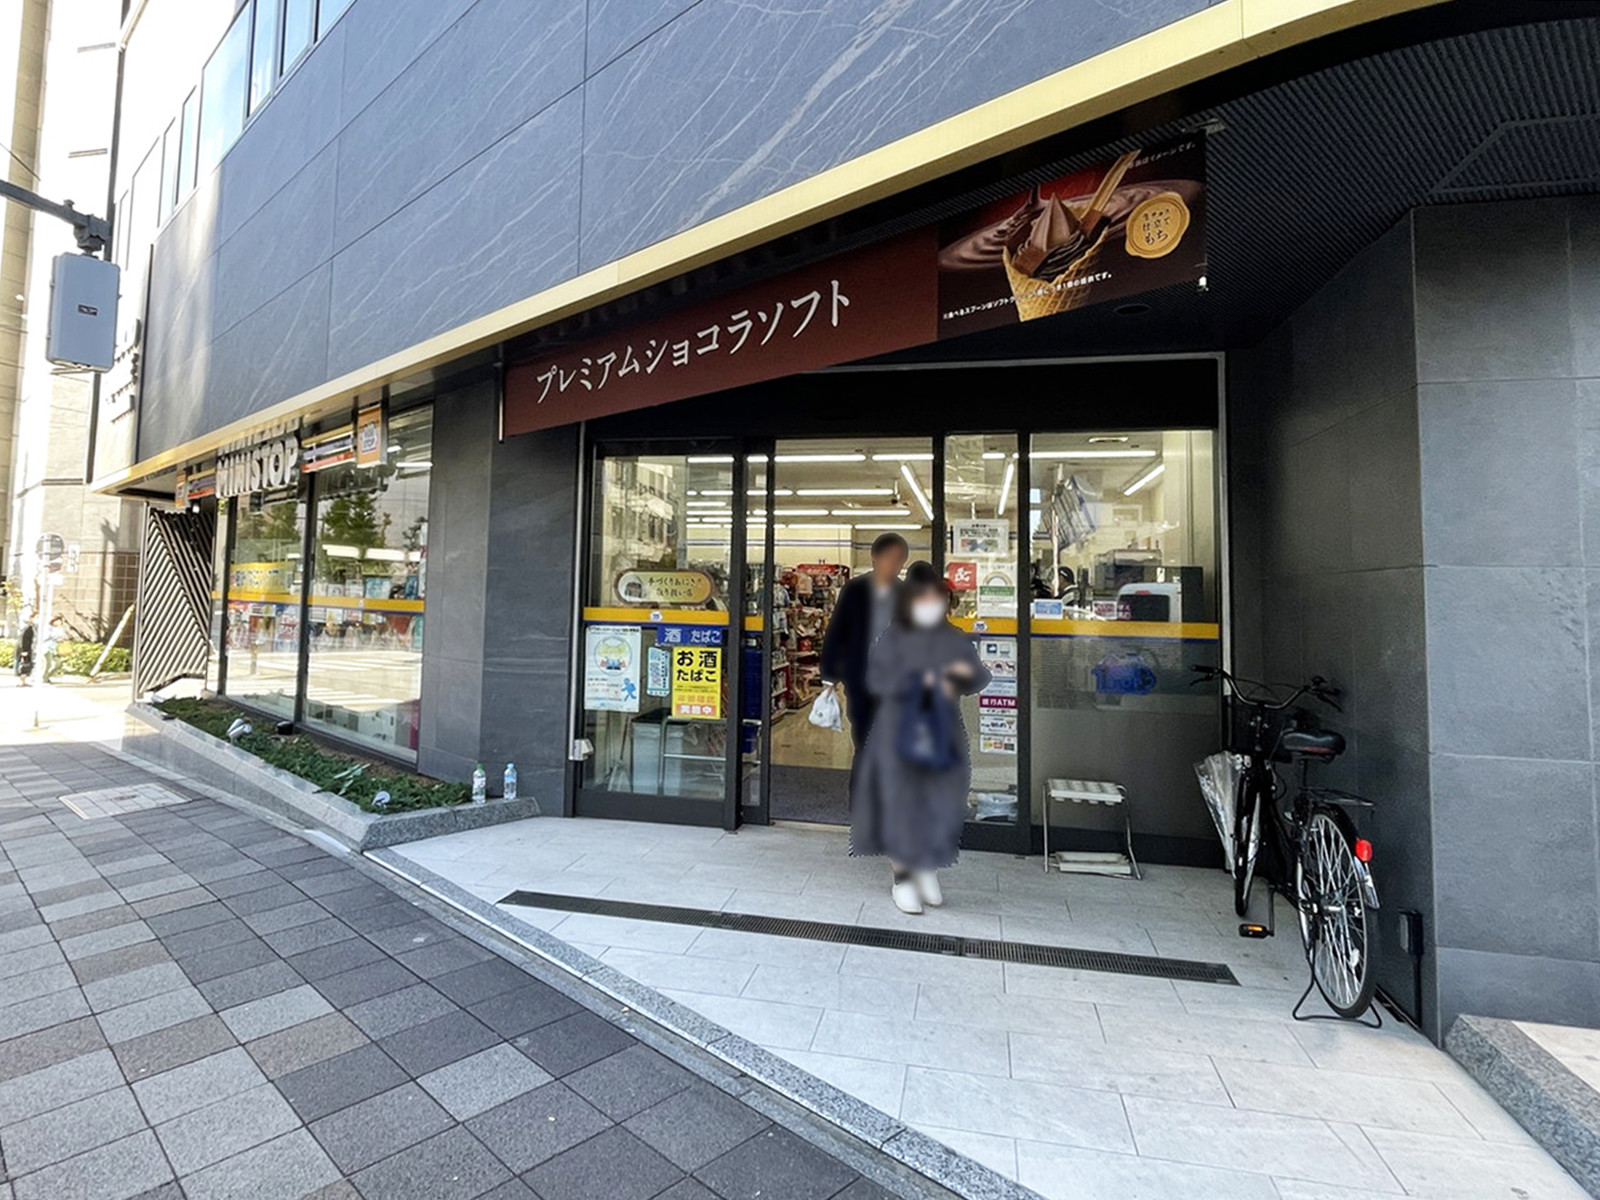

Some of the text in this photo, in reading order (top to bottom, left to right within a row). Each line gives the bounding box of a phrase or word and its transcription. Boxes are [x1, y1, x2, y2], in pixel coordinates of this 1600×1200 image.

[536, 279, 850, 404] プレミアムショコラソフト
[664, 627, 722, 644] 酒 たばこ
[676, 650, 718, 668] お酒
[676, 669, 718, 683] たばこ
